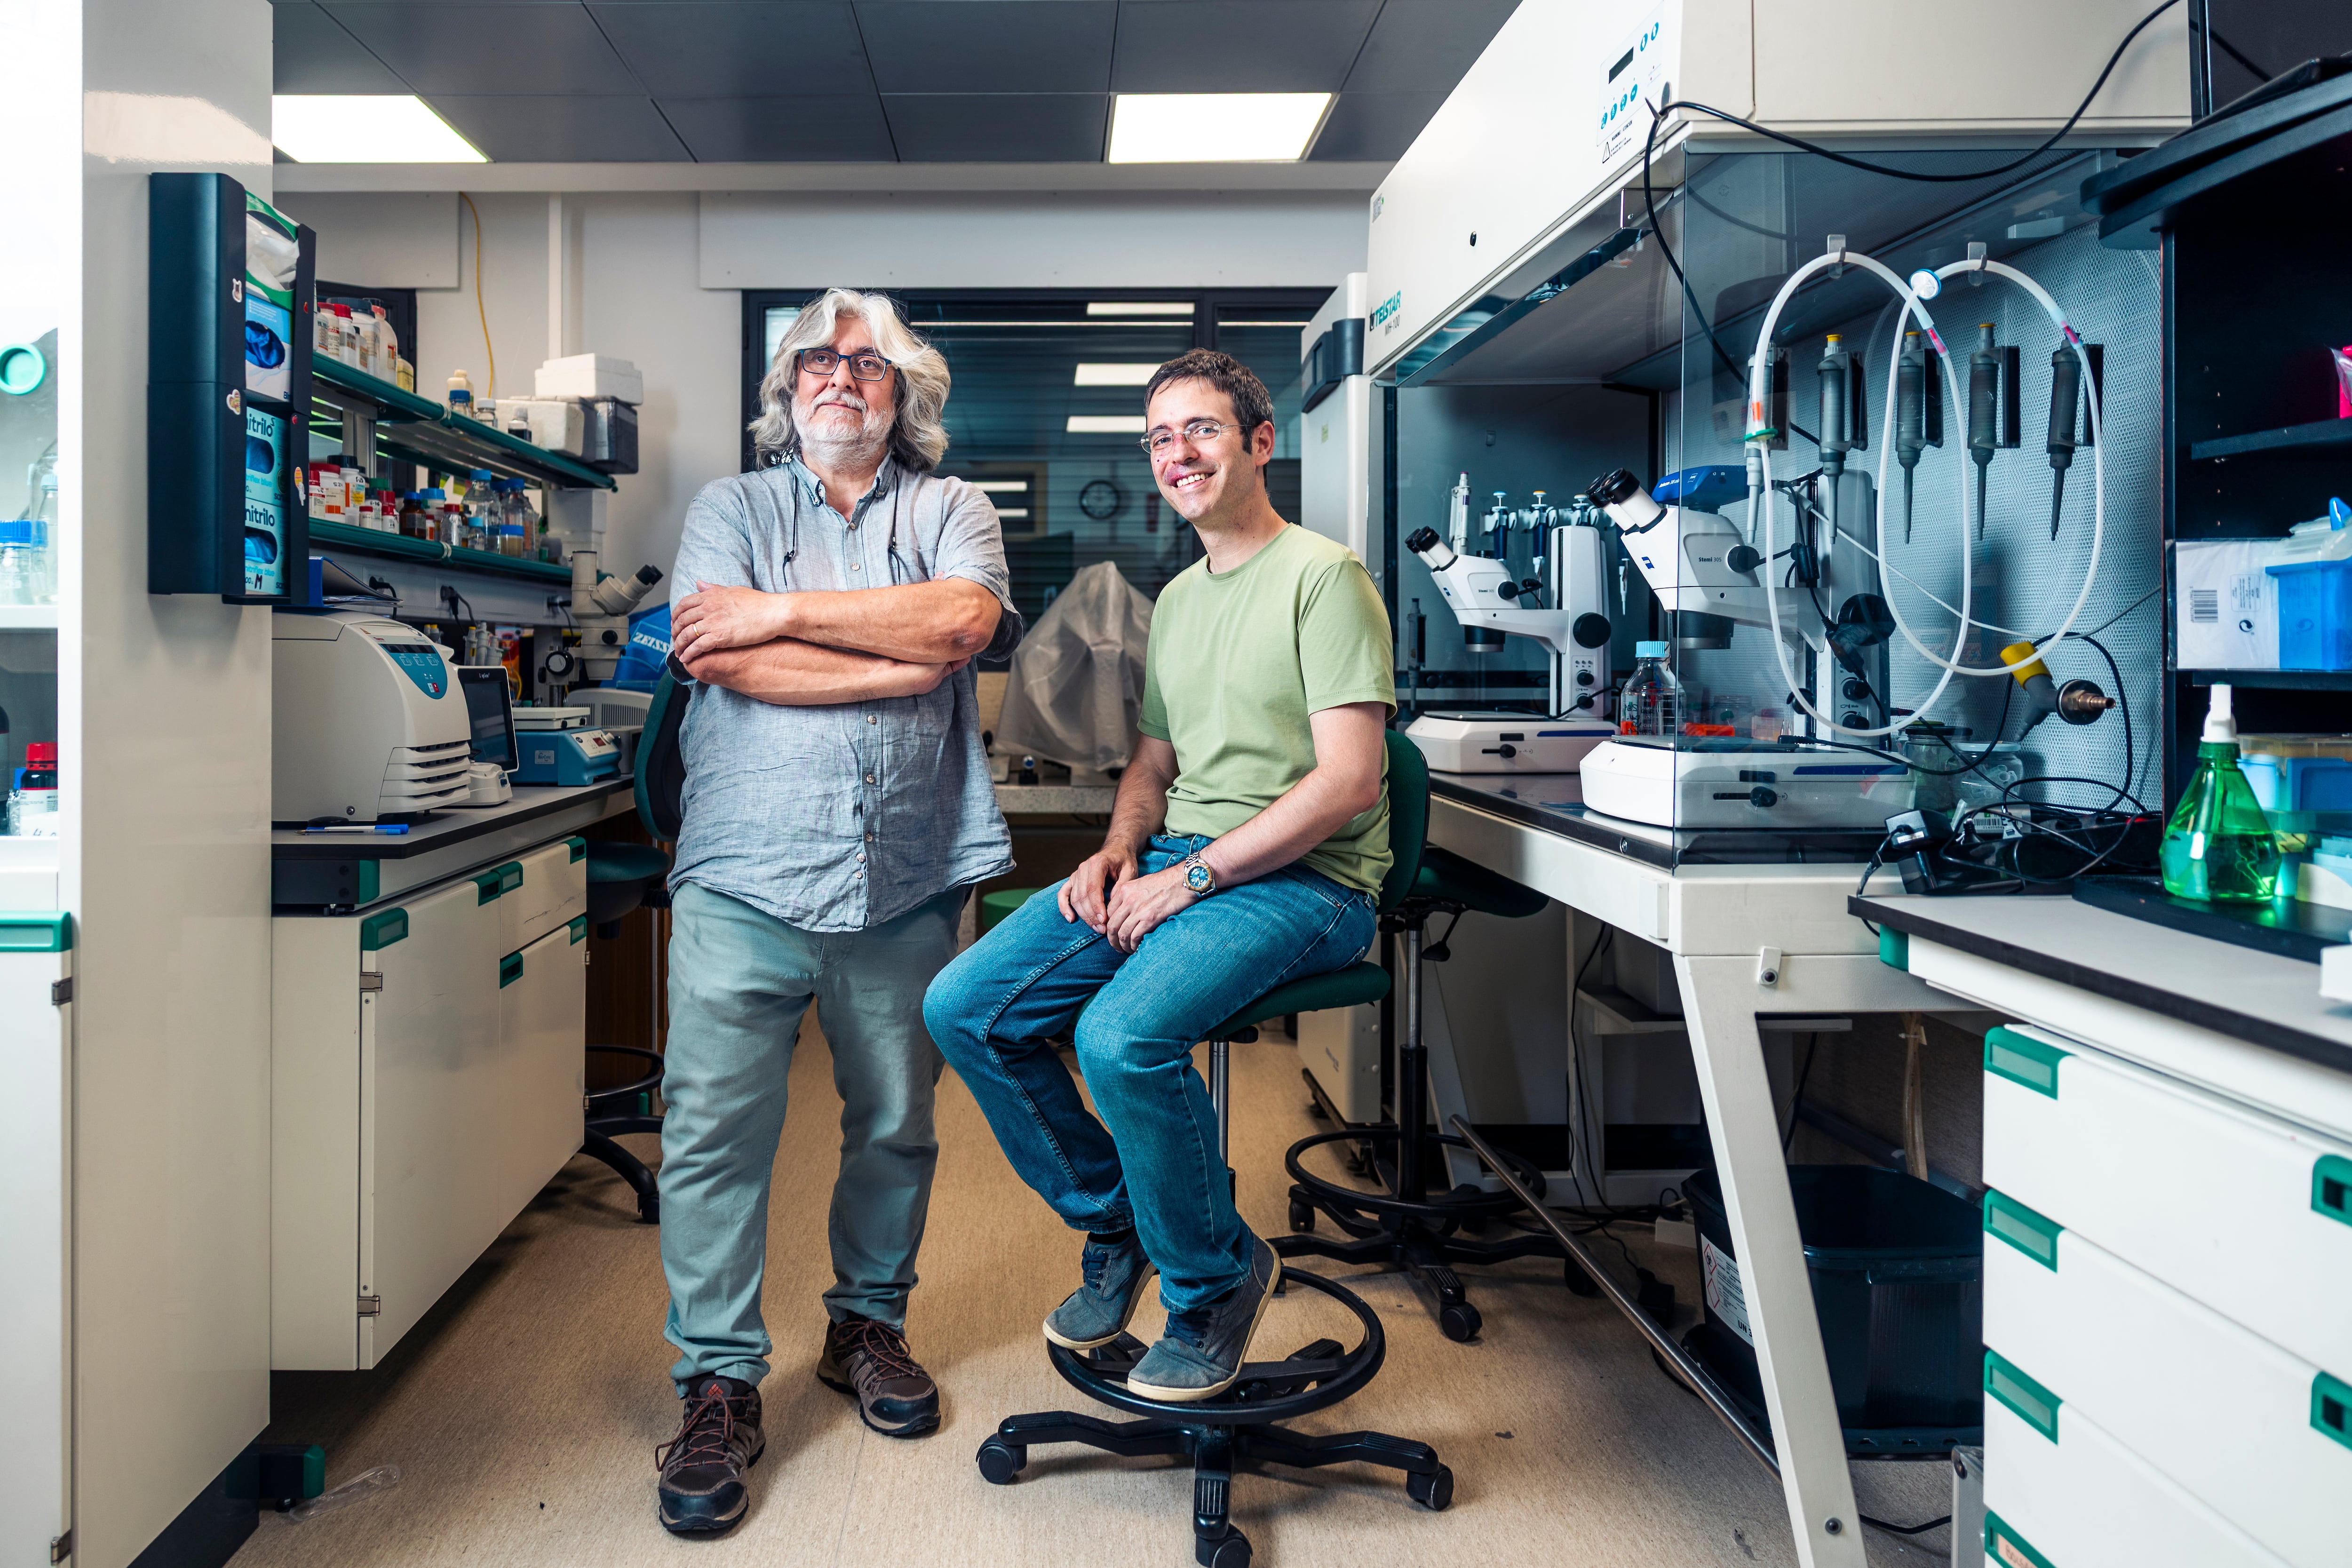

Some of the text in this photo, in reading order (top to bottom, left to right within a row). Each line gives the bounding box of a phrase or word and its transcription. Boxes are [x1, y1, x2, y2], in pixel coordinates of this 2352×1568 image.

[1375, 290, 1401, 327] TELSTAR
[246, 413, 273, 437] itrilo
[245, 505, 275, 527] nitrilo
[255, 573, 262, 589] M
[264, 568, 275, 577] blue
[632, 631, 670, 653] ZEISS
[1738, 1320, 1747, 1334] UN
